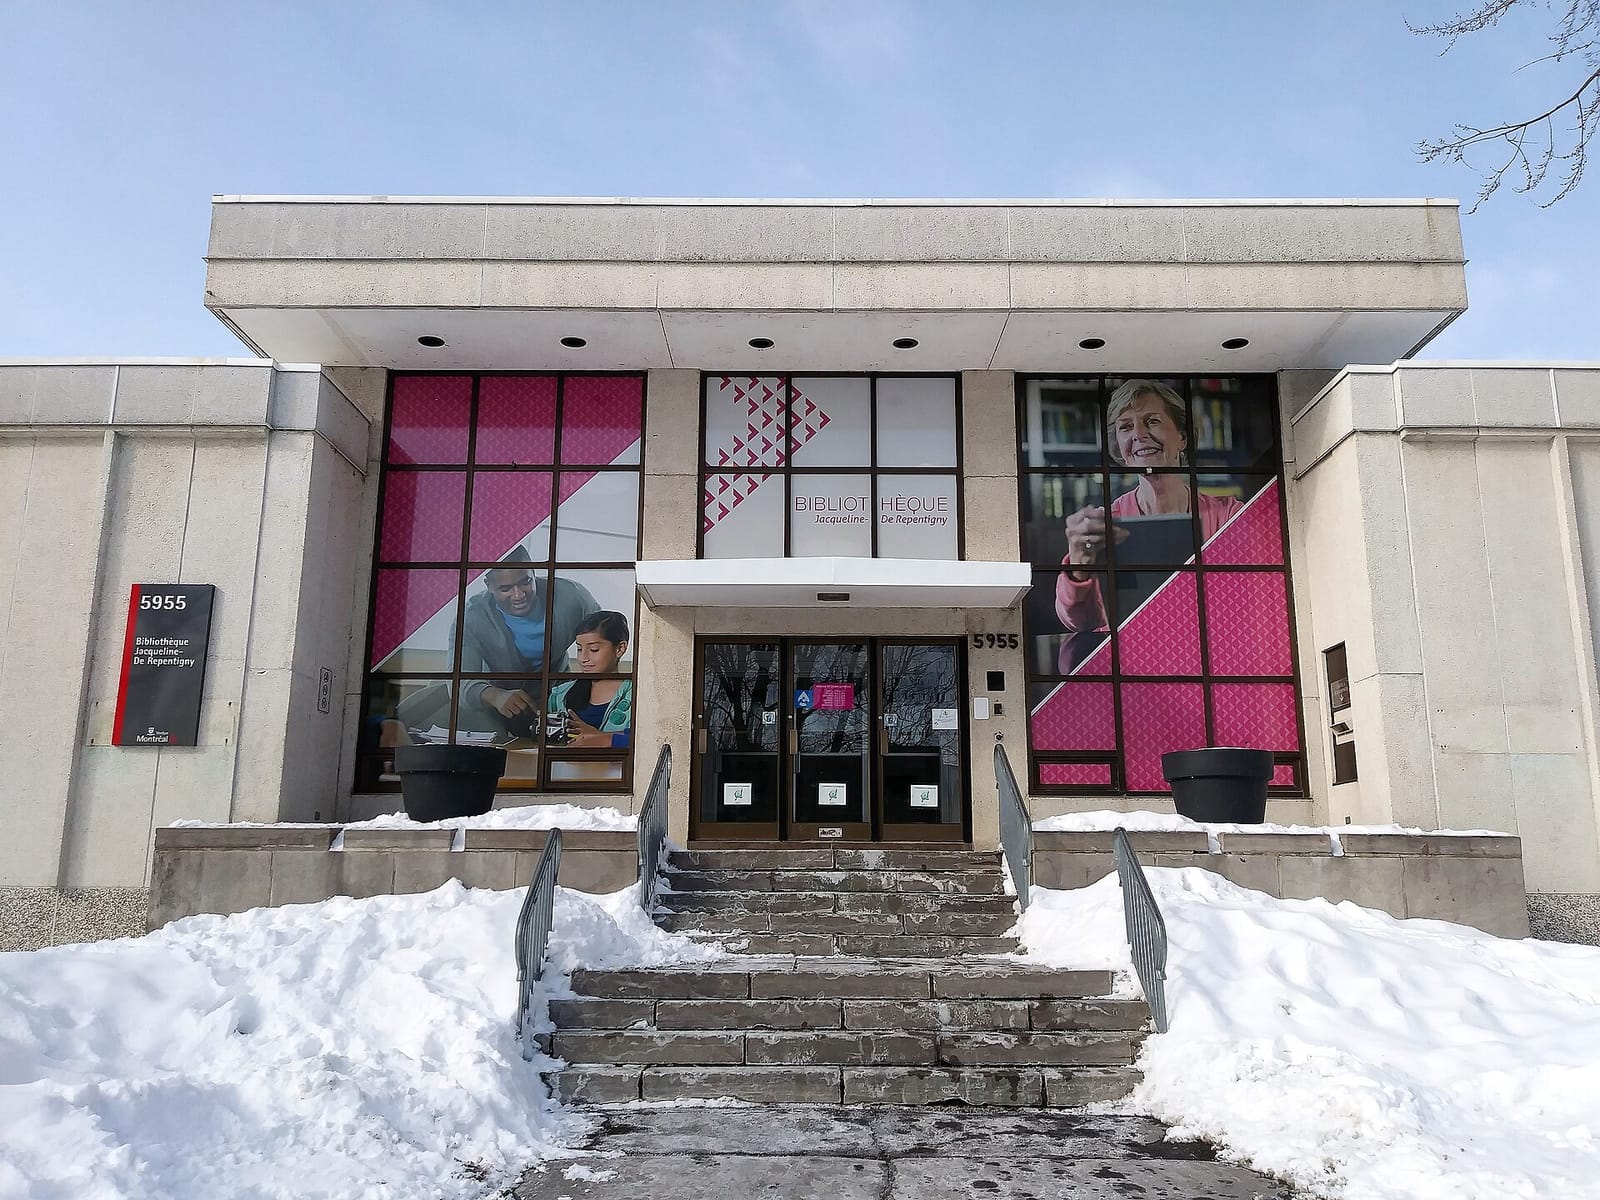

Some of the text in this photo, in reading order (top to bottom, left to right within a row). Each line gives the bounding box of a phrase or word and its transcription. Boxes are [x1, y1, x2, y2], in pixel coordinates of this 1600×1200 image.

[814, 515, 948, 525] Jacqueline- De Repentigny
[140, 595, 187, 610] 5955
[136, 637, 189, 648] Bibliothèque
[973, 633, 1019, 649] 5955
[134, 647, 184, 656] Jacqueline-
[133, 657, 195, 667] De Repentigny
[136, 735, 169, 743] Montréal
